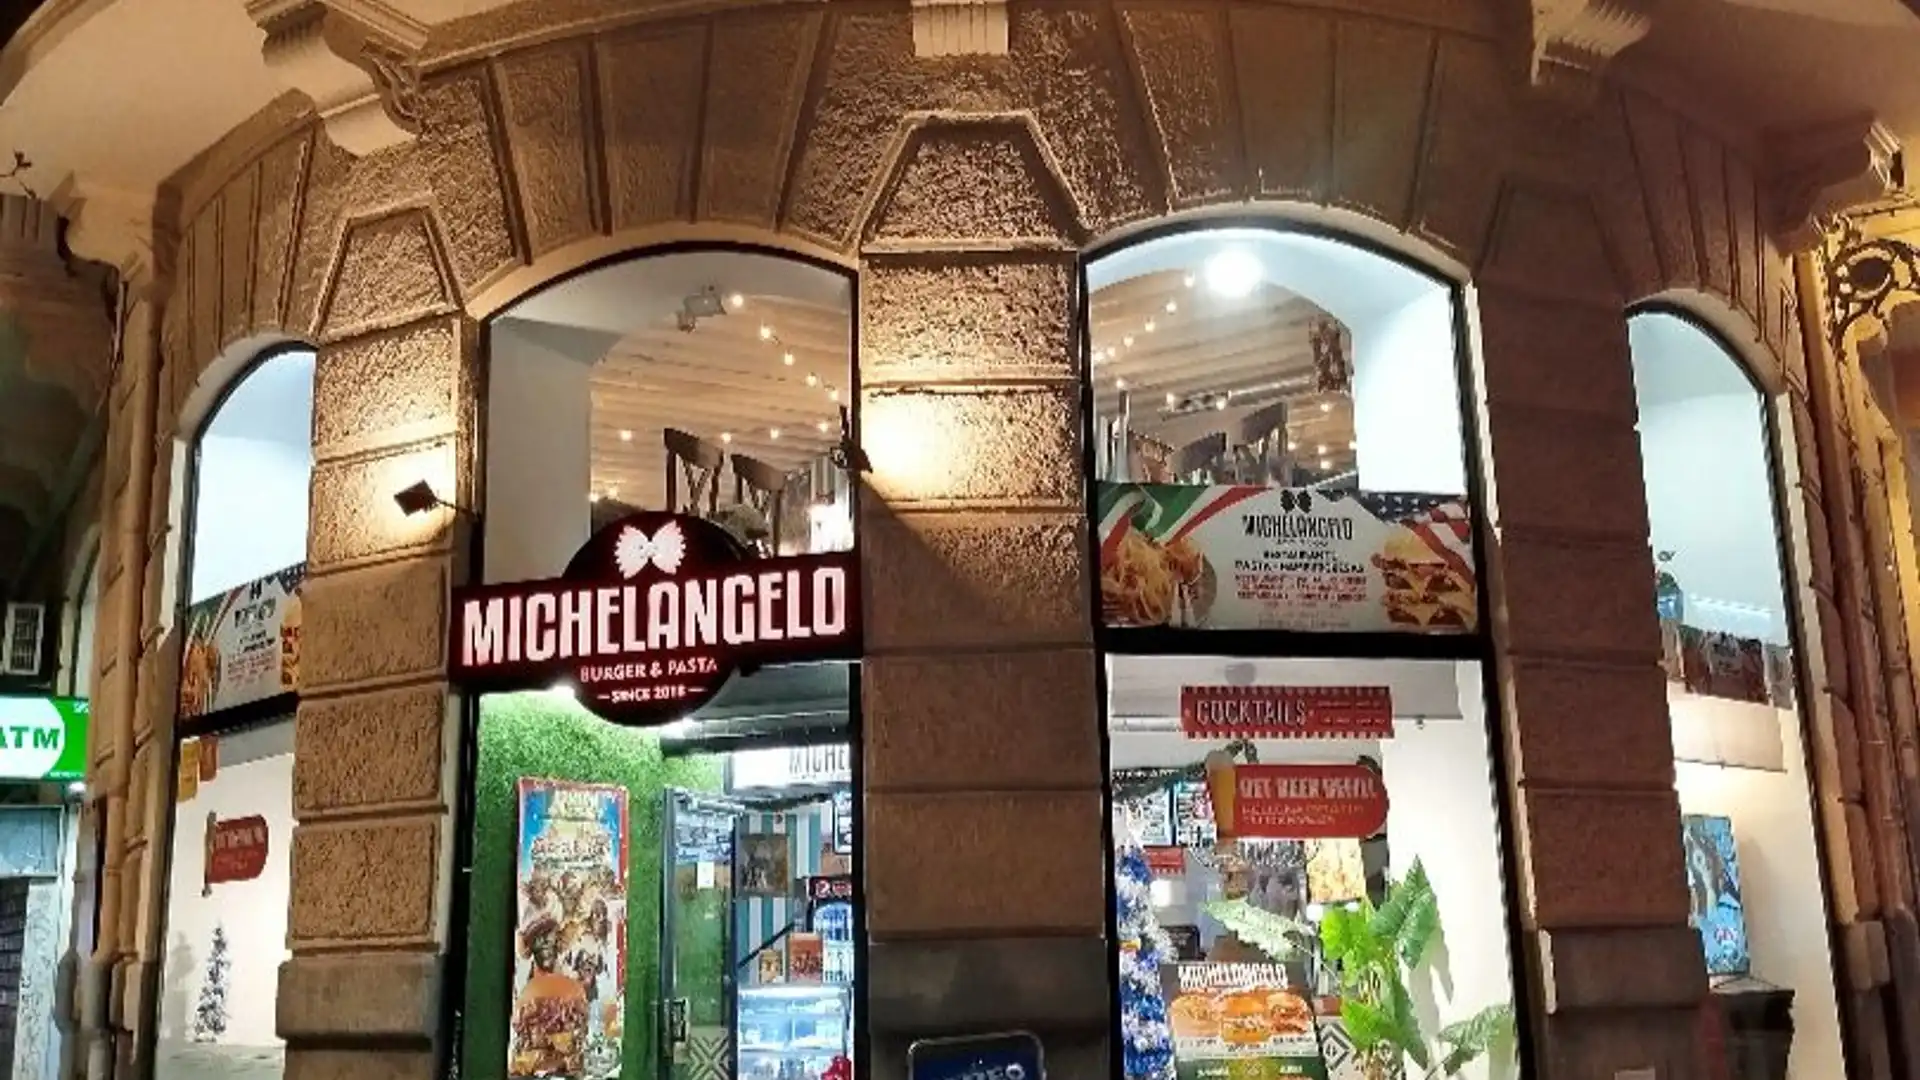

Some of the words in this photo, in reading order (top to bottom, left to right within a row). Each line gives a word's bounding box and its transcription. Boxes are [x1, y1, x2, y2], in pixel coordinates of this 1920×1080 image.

[461, 566, 847, 667] MICHELANGELO
[579, 663, 647, 683] BURGER
[650, 660, 663, 678] &
[668, 656, 718, 676] PASTA
[611, 688, 651, 704] SINCE
[1196, 699, 1307, 727] COCKTAILS
